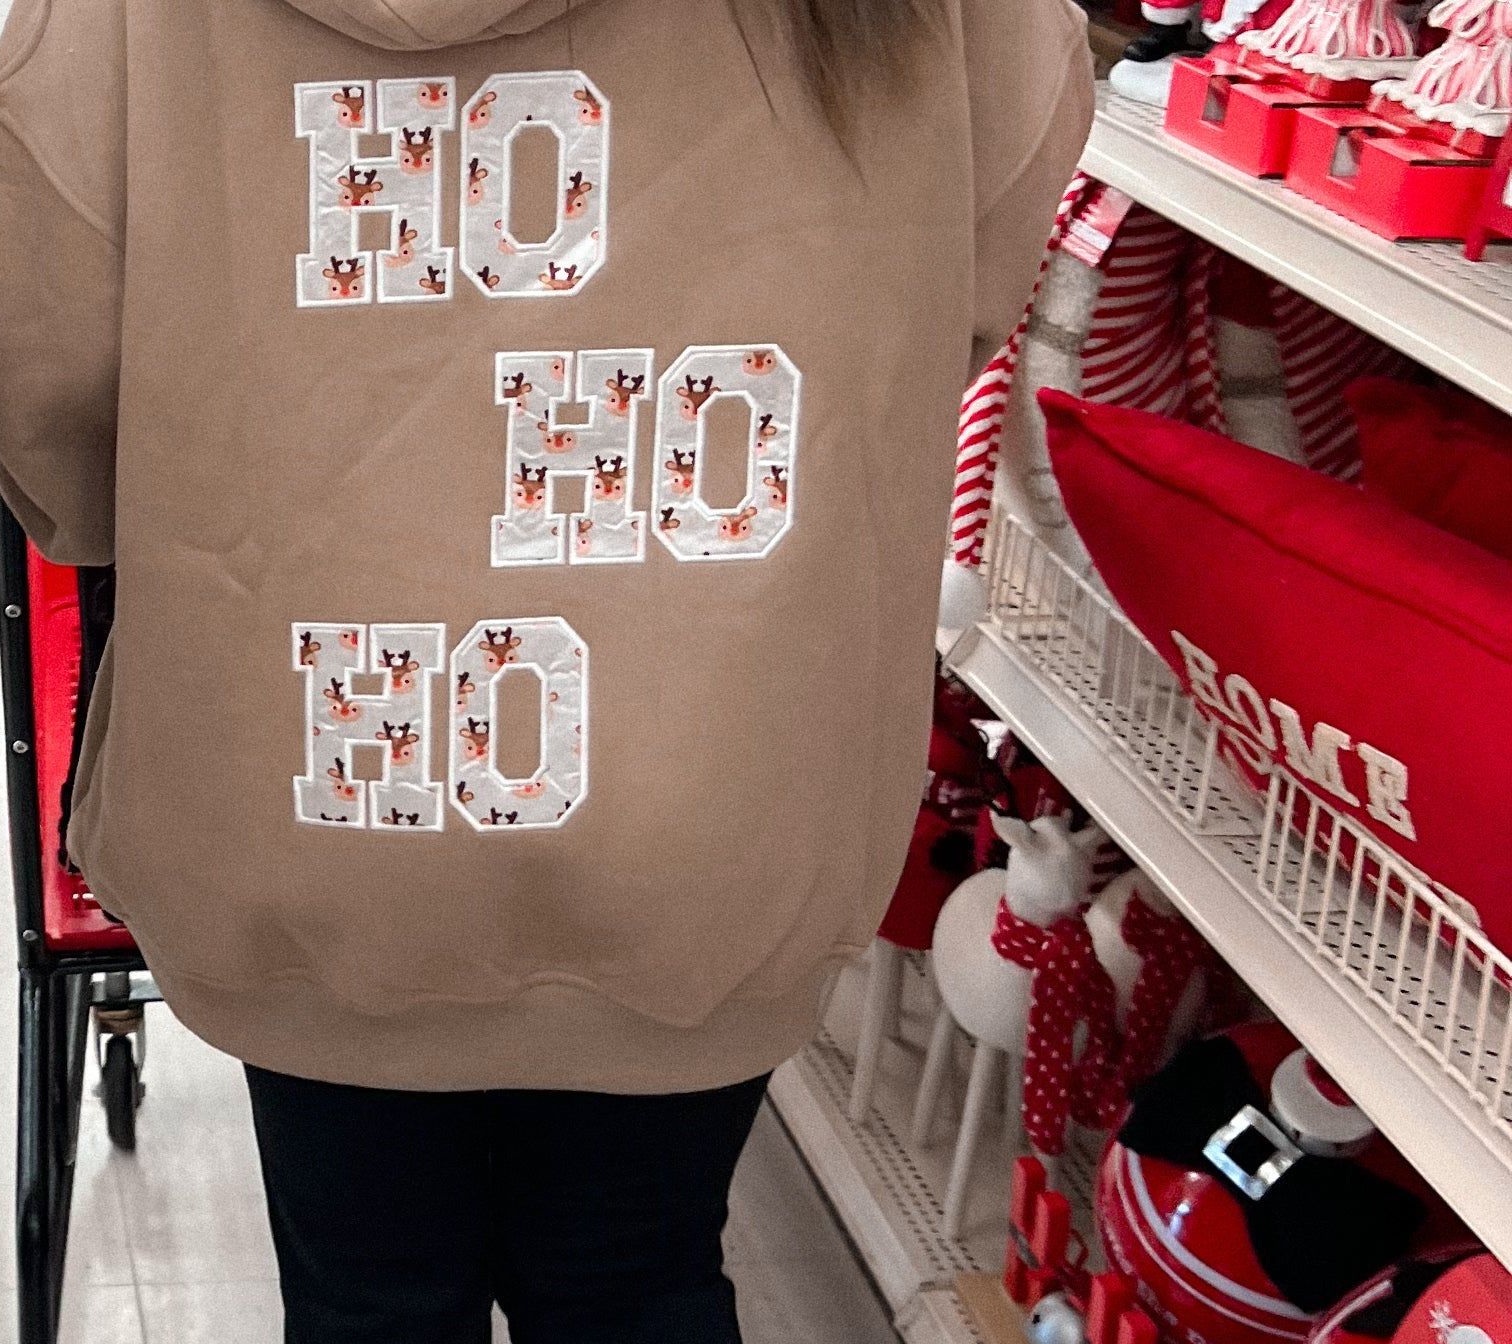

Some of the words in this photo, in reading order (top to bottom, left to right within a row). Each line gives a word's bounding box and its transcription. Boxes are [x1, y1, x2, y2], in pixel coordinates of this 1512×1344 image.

[293, 69, 611, 307] HO
[491, 343, 802, 568] HO
[290, 615, 590, 832] HO
